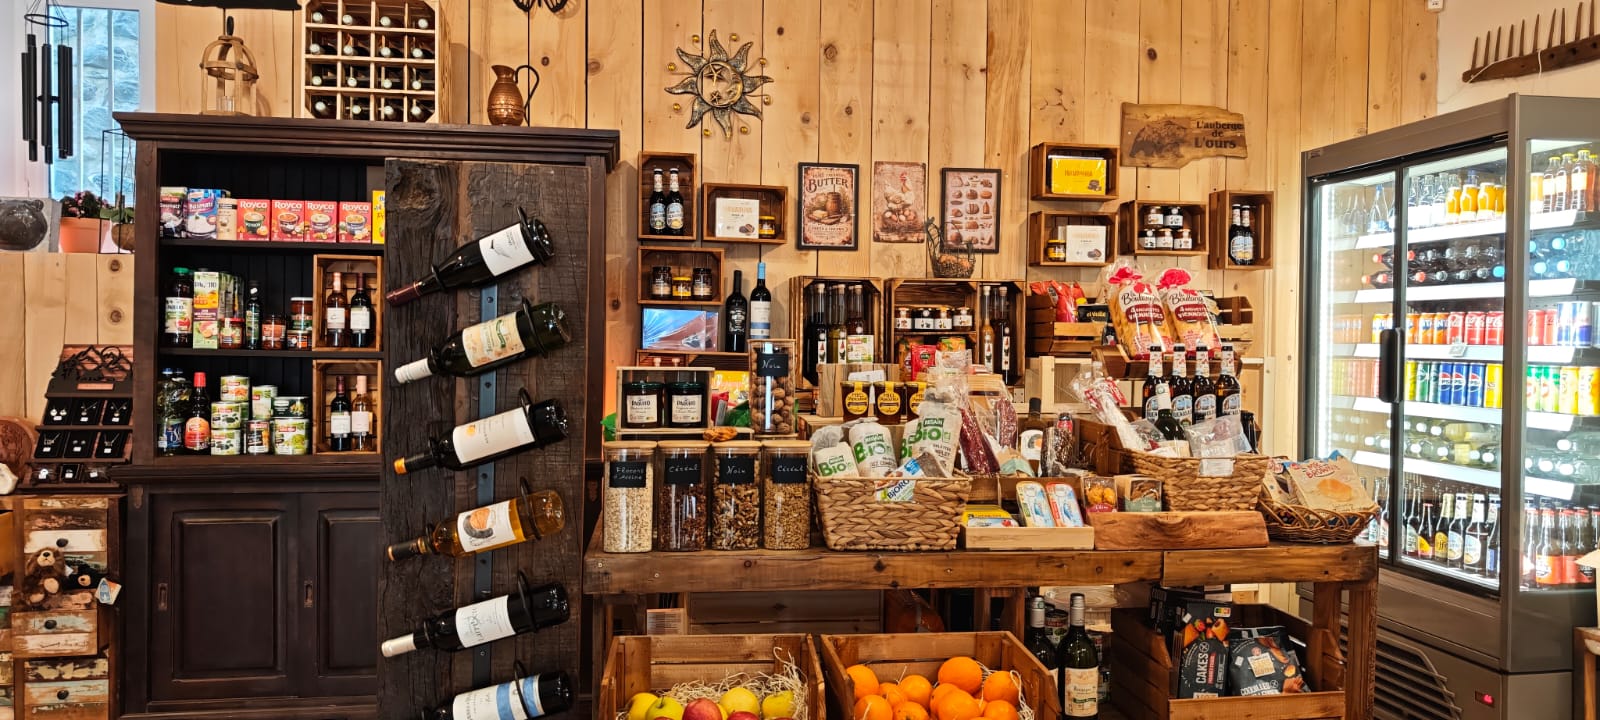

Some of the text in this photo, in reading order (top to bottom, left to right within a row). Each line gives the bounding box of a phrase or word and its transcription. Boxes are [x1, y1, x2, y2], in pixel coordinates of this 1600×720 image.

[1196, 121, 1245, 131] L'auberge
[1194, 137, 1237, 149] L'ours
[806, 178, 848, 193] BUTTER
[1195, 652, 1209, 684] CAKES
